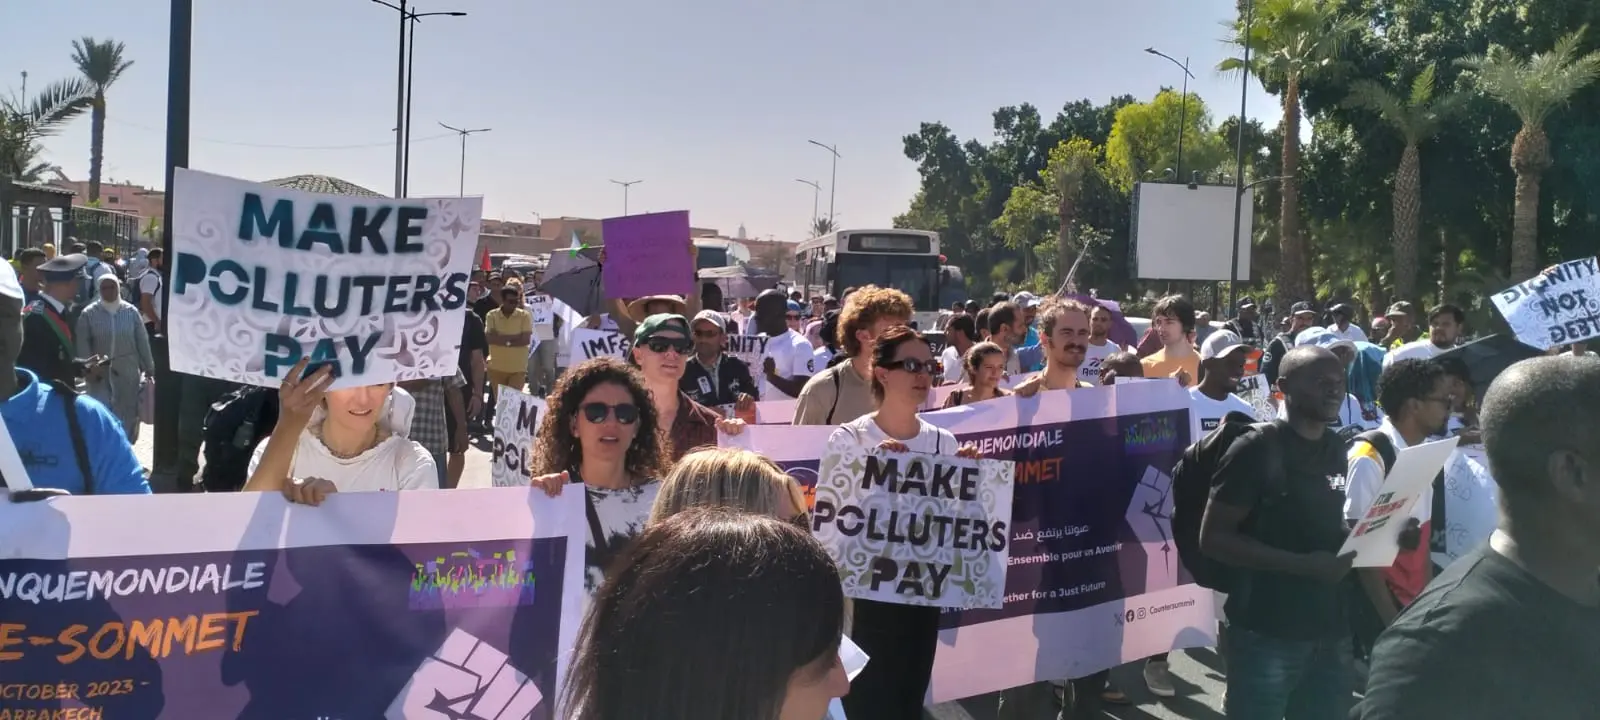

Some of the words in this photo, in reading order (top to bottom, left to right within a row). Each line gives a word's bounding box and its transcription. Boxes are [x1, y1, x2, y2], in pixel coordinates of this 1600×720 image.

[238, 192, 428, 255] MAKE
[174, 251, 469, 318] POLLUTERS
[1500, 258, 1595, 304] DIGNITY
[1539, 289, 1587, 318] NOT
[1548, 315, 1600, 343] DEBT
[264, 331, 381, 378] PAY
[724, 335, 769, 354] NITY
[1082, 367, 1101, 377] Ree
[516, 401, 538, 436] M
[492, 437, 531, 477] POL
[861, 455, 979, 501] MAKE
[812, 501, 1007, 553] POLLUTERS
[1012, 529, 1034, 542] ضد
[1036, 526, 1063, 543] يرتفع
[1064, 523, 1090, 537] صوتنا
[1008, 552, 1059, 567] Ensemble
[1061, 549, 1083, 562] pour
[1095, 542, 1124, 556] Avenir
[870, 557, 952, 598] PAY
[1003, 592, 1031, 604] ether
[1031, 589, 1047, 600] for
[1049, 590, 1057, 598] a
[1058, 586, 1080, 598] Just
[1080, 580, 1107, 593] Future
[1149, 598, 1195, 615] Countersummit
[86, 679, 134, 698] 2023
